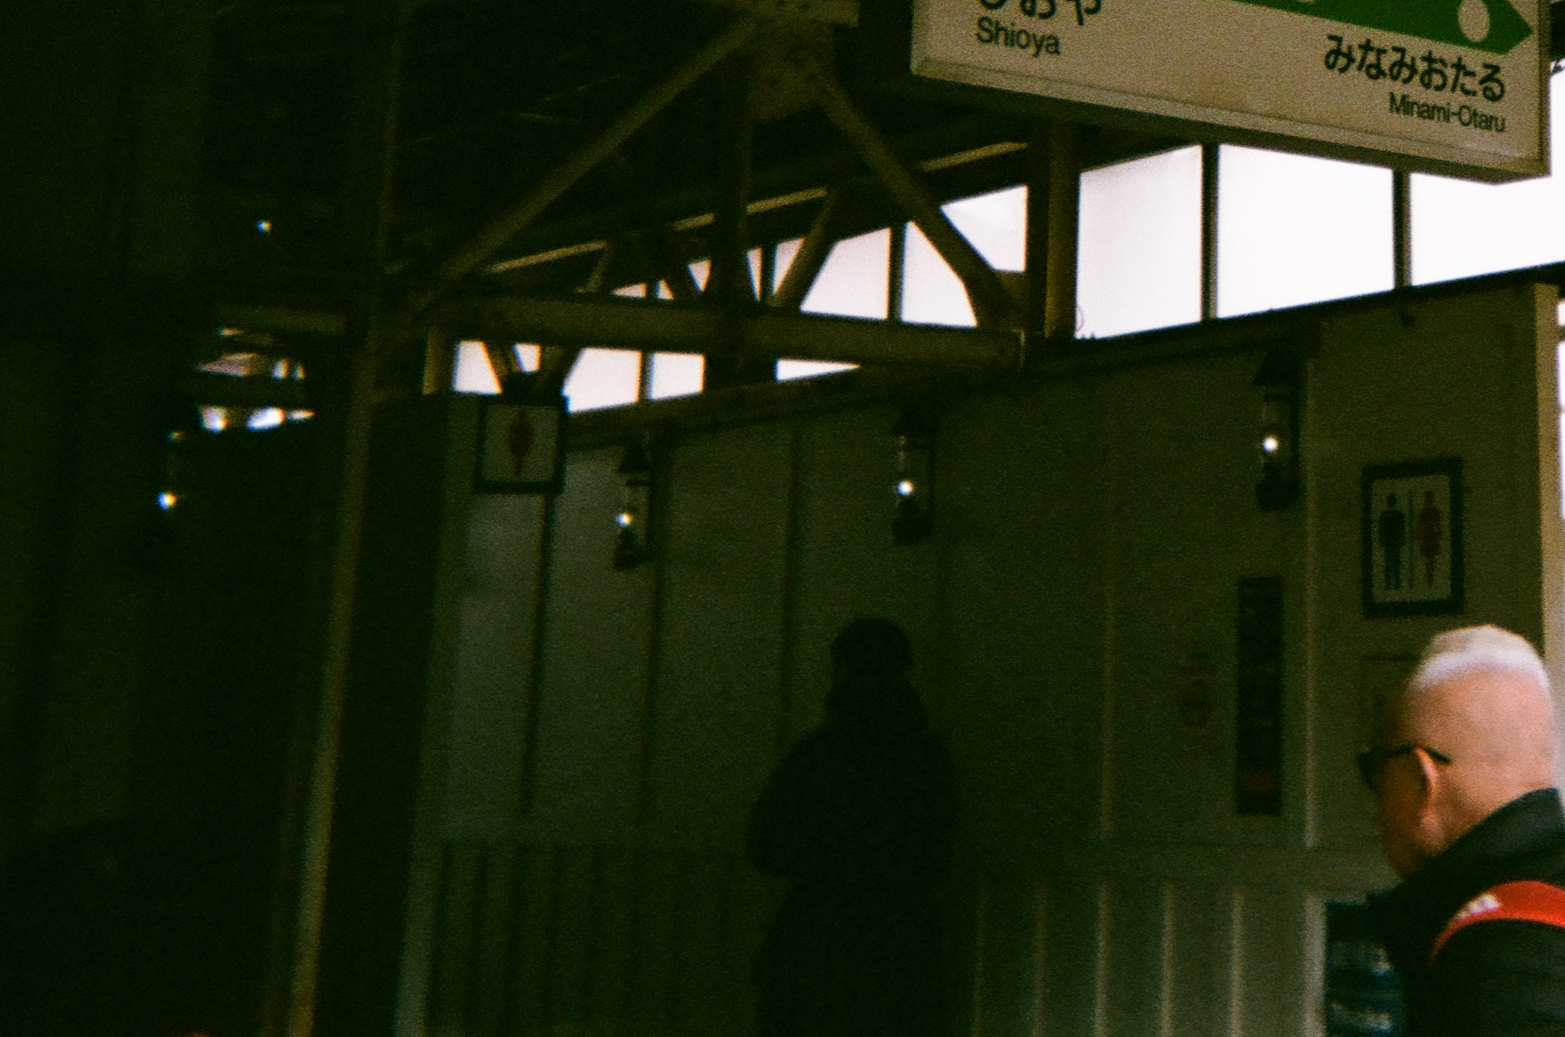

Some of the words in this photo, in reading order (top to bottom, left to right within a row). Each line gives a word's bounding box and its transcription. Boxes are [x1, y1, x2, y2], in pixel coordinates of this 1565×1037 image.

[976, 17, 1061, 57] Shioya
[1323, 34, 1506, 103] みなみおたる
[1389, 92, 1506, 134] Minami-Otaru
